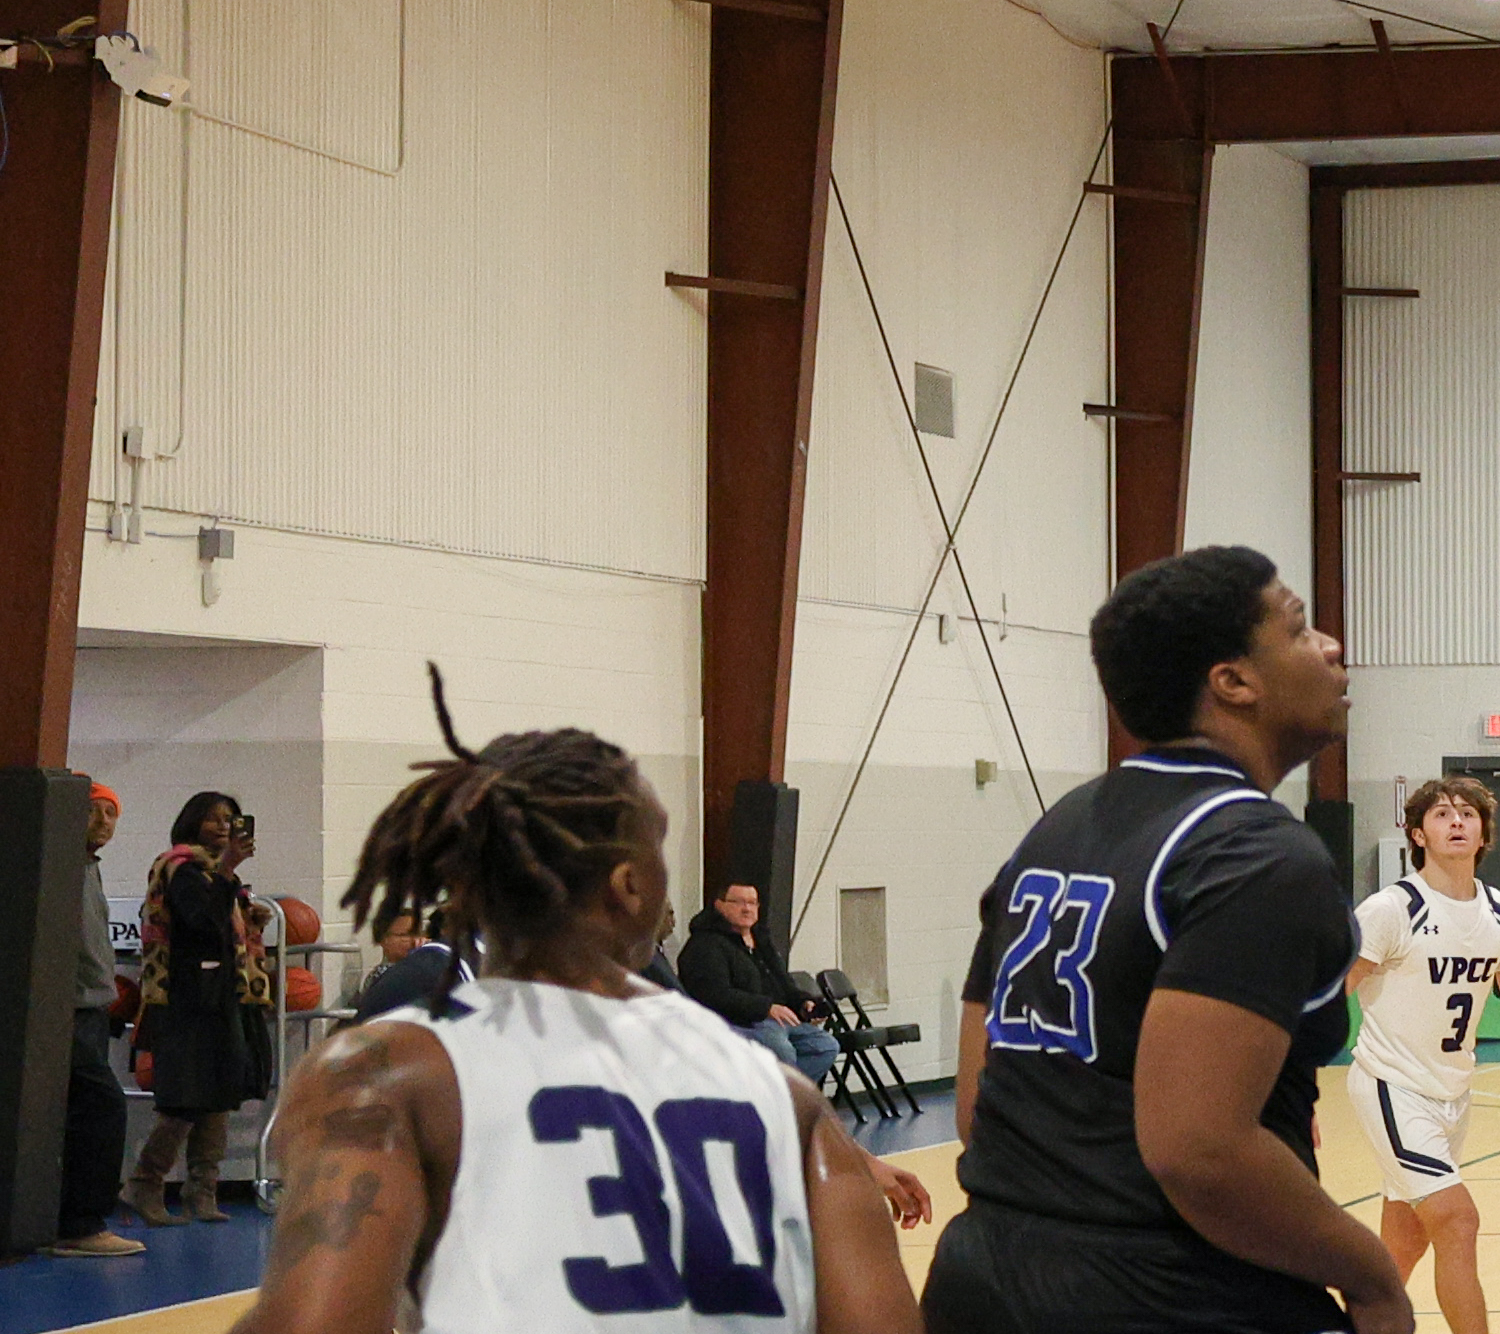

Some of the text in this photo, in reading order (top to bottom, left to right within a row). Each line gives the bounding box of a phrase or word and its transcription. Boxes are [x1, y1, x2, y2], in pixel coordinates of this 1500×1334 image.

[985, 868, 1116, 1063] 23
[1427, 957, 1498, 984] VPCC
[1441, 993, 1473, 1053] 3
[528, 1085, 786, 1317] 30
